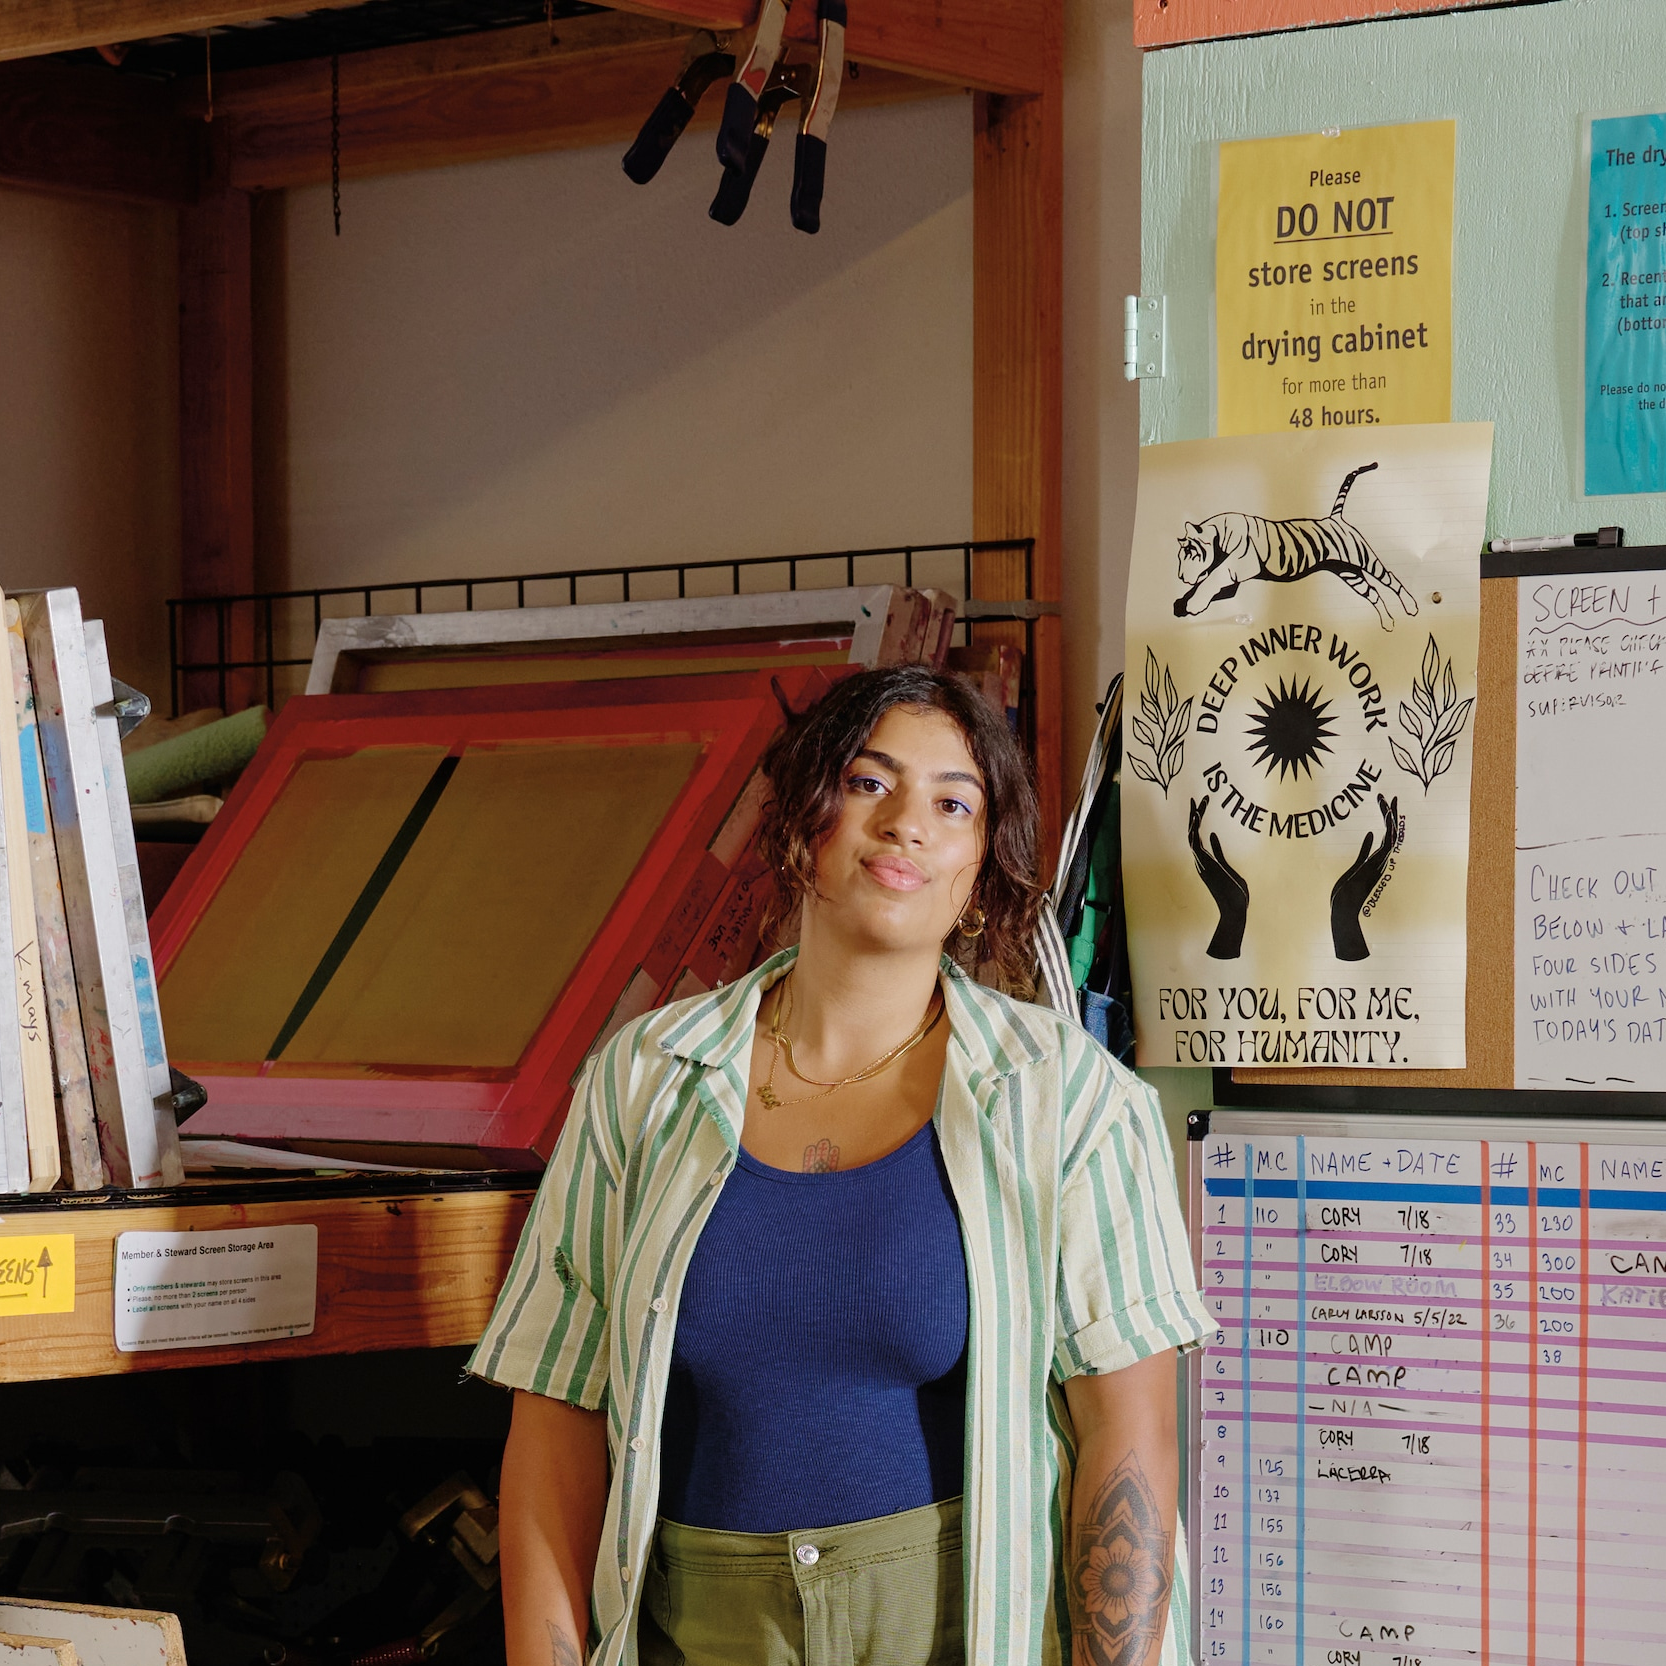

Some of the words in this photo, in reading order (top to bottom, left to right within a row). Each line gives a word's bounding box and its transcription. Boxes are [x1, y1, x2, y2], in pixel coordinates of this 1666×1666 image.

[1606, 149, 1636, 167] The
[1310, 169, 1361, 187] Please
[1276, 203, 1318, 239] DO
[1333, 196, 1395, 234] NOT
[1605, 204, 1617, 218] 1.
[1620, 225, 1650, 244] (top
[1248, 261, 1312, 287] store
[1323, 254, 1419, 281] screens
[1602, 273, 1615, 287] 2.
[1310, 298, 1324, 315] in
[1331, 296, 1356, 314] the
[1620, 295, 1649, 309] that
[1242, 330, 1321, 365] drying
[1332, 322, 1428, 354] cabinet
[1282, 377, 1303, 394] for
[1309, 376, 1346, 393] more
[1352, 372, 1387, 391] than
[1600, 384, 1634, 396] Please
[1637, 382, 1650, 394] do
[1289, 407, 1313, 428] 48
[1321, 406, 1380, 426] hours.
[1638, 399, 1656, 410] the
[1533, 584, 1630, 622] SCREEN
[1196, 656, 1239, 735] DEEP
[1239, 623, 1323, 669] INNER
[1327, 633, 1389, 734] WORK
[1202, 761, 1229, 790] IS
[1215, 782, 1264, 833] THE
[1269, 757, 1383, 839] MEDICINE
[1531, 864, 1598, 902] CHECK
[1614, 867, 1657, 894] OUT
[1533, 914, 1604, 940] BELOW
[1532, 954, 1578, 977] FOUR
[1590, 952, 1659, 976] SIDES
[1158, 987, 1208, 1020] FOR
[1218, 987, 1288, 1024] YOU,
[1297, 987, 1357, 1020] FOR
[1365, 987, 1420, 1024] ME,
[1530, 987, 1576, 1011] WITH
[1590, 984, 1650, 1010] YOUR
[1531, 1018, 1617, 1043] TODAY'S
[1174, 1030, 1226, 1063] FOR
[1237, 1030, 1409, 1064] HUMANITY.
[1311, 1152, 1372, 1176] NAME
[1397, 1149, 1460, 1174] DATE
[1540, 1164, 1565, 1182] MC
[1601, 1158, 1664, 1181] NAME
[1321, 1206, 1361, 1226] CORY
[1397, 1205, 1430, 1230] 7/18
[122, 1251, 154, 1260] Member
[156, 1250, 162, 1258] &
[164, 1247, 197, 1257] Steward
[199, 1245, 226, 1255] Screen
[228, 1243, 256, 1253] Storage
[257, 1241, 274, 1250] Area
[1321, 1243, 1358, 1263] CORY
[1400, 1245, 1432, 1267] 7/18
[1327, 1365, 1407, 1388] CAMP
[1401, 1434, 1431, 1454] 7/18
